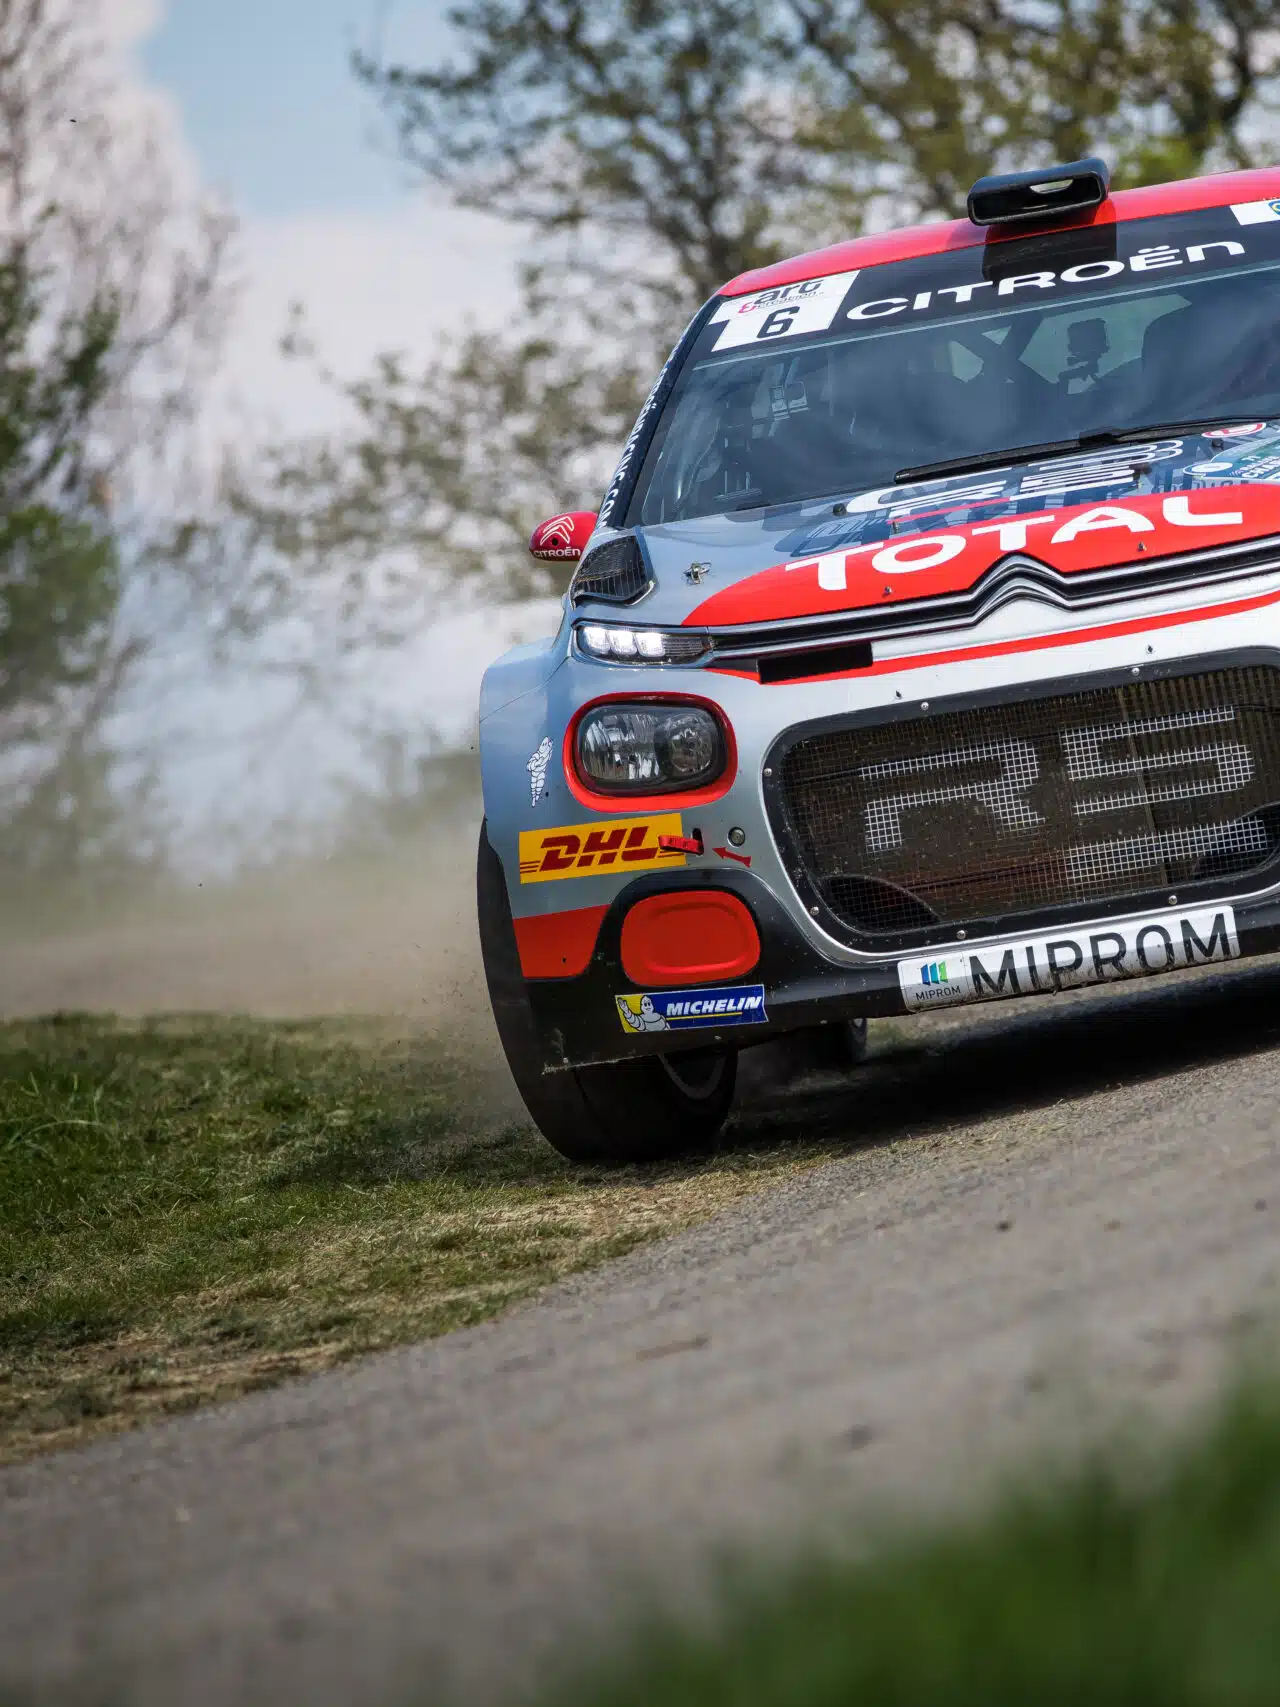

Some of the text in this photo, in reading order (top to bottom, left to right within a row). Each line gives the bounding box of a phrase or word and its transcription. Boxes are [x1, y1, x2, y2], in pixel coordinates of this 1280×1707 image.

[756, 305, 801, 339] 6
[533, 545, 582, 558] CITROËN
[784, 495, 1244, 592] TOTAL
[538, 825, 660, 873] DHL
[968, 912, 1233, 997] MIPROM
[665, 995, 763, 1017] MICHELIN
[914, 984, 962, 1001] MIPROM
